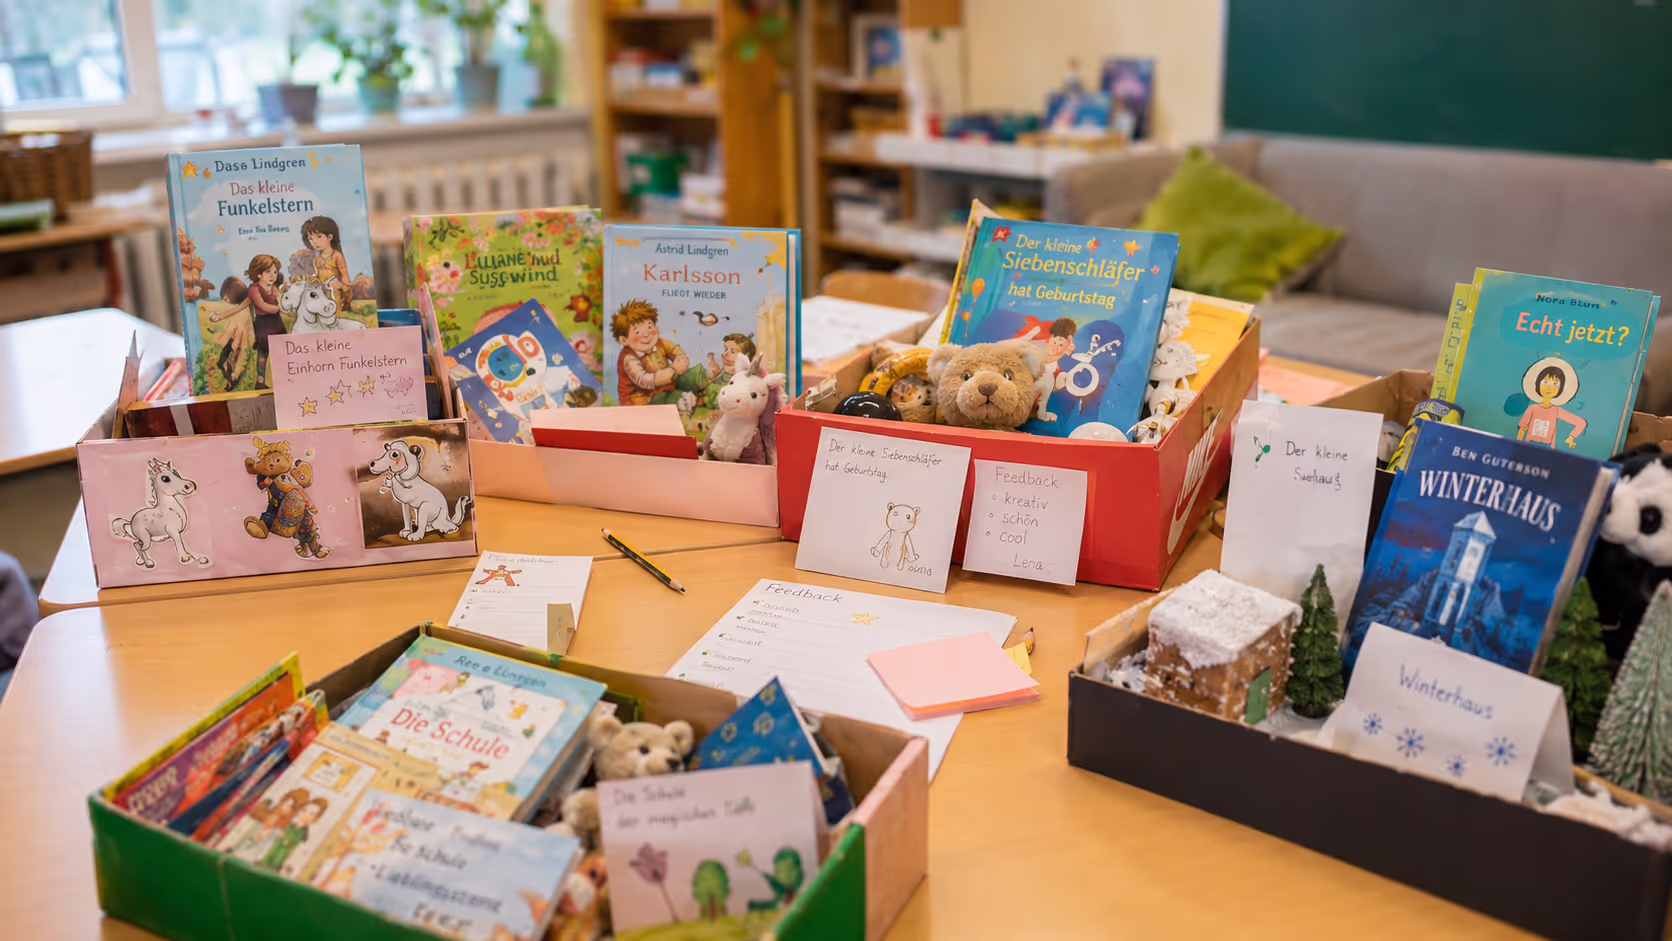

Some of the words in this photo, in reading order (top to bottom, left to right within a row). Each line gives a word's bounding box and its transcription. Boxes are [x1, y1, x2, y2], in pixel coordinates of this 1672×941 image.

[229, 182, 254, 196] Das
[258, 180, 294, 194] kleine
[217, 197, 314, 216] Funkelstern
[655, 243, 684, 254] Astrid
[688, 244, 729, 259] Lindgren
[1016, 234, 1041, 250] Der
[1044, 238, 1082, 254] kleine
[644, 263, 741, 284] Karlsson
[1002, 251, 1145, 286] Siebenschläfer
[662, 288, 690, 297] FLIEGT
[693, 290, 727, 299] WIEDER
[1008, 281, 1032, 298] hat
[1035, 285, 1116, 309] Geburtstag
[1536, 294, 1565, 305] Nora
[1516, 312, 1563, 336] Echt
[1565, 320, 1629, 346] jetzt?
[285, 341, 309, 355] Das
[316, 339, 352, 352] kleine
[287, 360, 335, 375] Einhorn
[338, 354, 408, 370] Funkelstern
[829, 438, 845, 452] Der
[851, 443, 875, 457] kleine
[1285, 440, 1306, 456] Der
[1316, 444, 1349, 461] kleine
[825, 460, 839, 472] hat
[1452, 446, 1477, 461] BEN
[1482, 453, 1552, 480] GUTERSON
[995, 466, 1059, 490] Feedback
[1004, 491, 1049, 510] kreativ
[1420, 470, 1562, 532] WINTERHAUS
[1002, 512, 1039, 527] schön
[1013, 553, 1043, 571] Lena
[765, 582, 844, 603] Feedback
[1400, 663, 1493, 720] Winterhaus
[390, 707, 429, 733] Die
[430, 720, 510, 760] Schule
